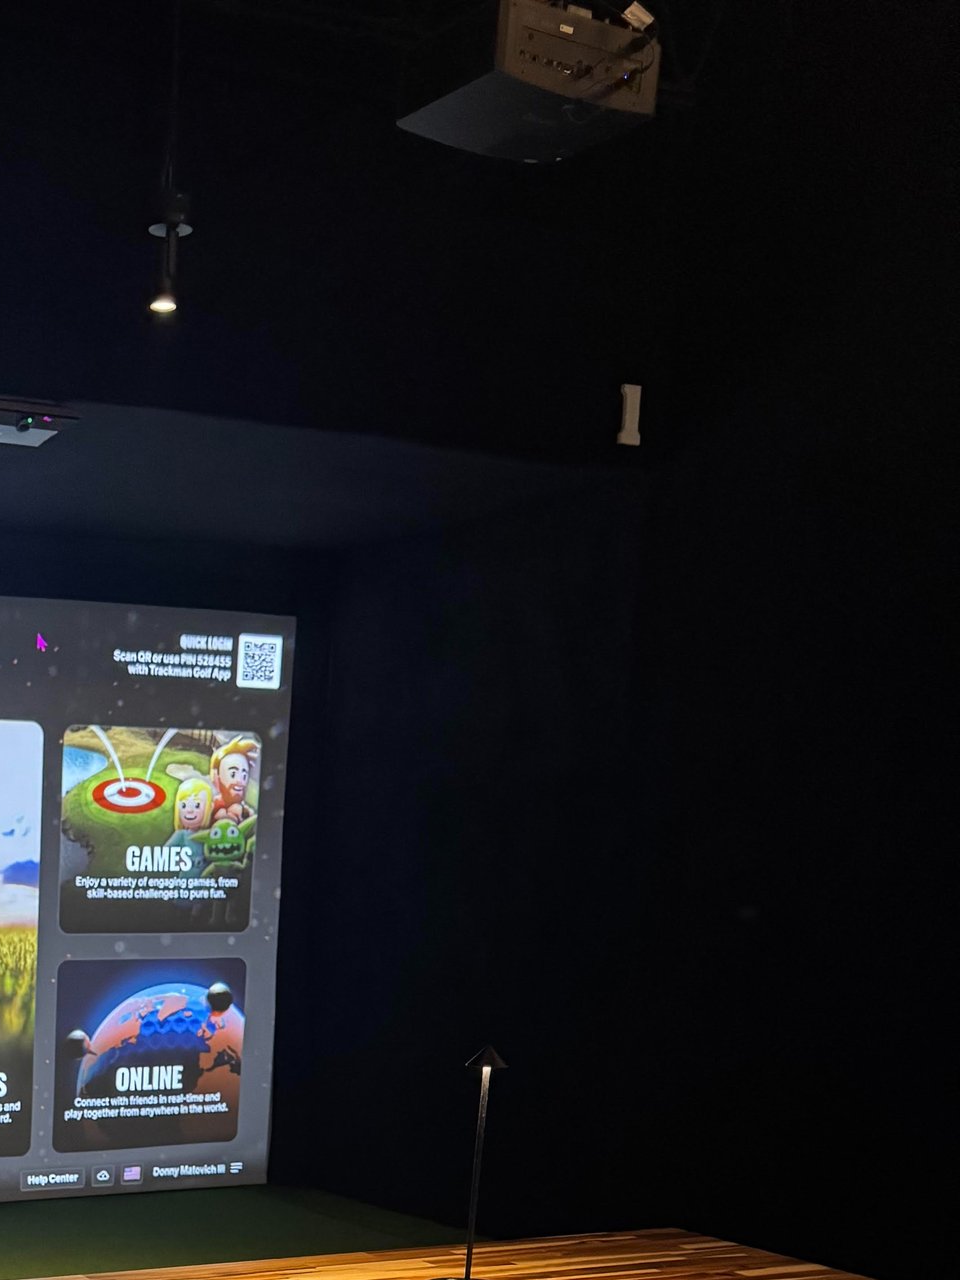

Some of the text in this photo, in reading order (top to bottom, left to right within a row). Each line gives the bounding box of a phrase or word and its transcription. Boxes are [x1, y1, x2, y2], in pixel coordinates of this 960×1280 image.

[180, 634, 233, 651] QUICK LOGIN
[113, 649, 137, 662] Scan
[138, 651, 152, 663] QR
[152, 654, 163, 664] or
[163, 654, 180, 665] use
[181, 654, 196, 666] PIN
[128, 664, 231, 682] with Trackman Golf App
[126, 846, 193, 872] GAMES
[76, 876, 238, 889] Enjoy a variety of engaging games, from
[87, 889, 226, 901] skill-based challenges to pure fun.
[116, 1065, 184, 1091] ONLINE
[4, 1101, 21, 1112] and
[74, 1092, 221, 1108] Connect with friends in real-time and
[64, 1103, 229, 1122] play together from anywhere in the world.
[27, 1173, 79, 1187] Help Center
[153, 1167, 179, 1178] Donny
